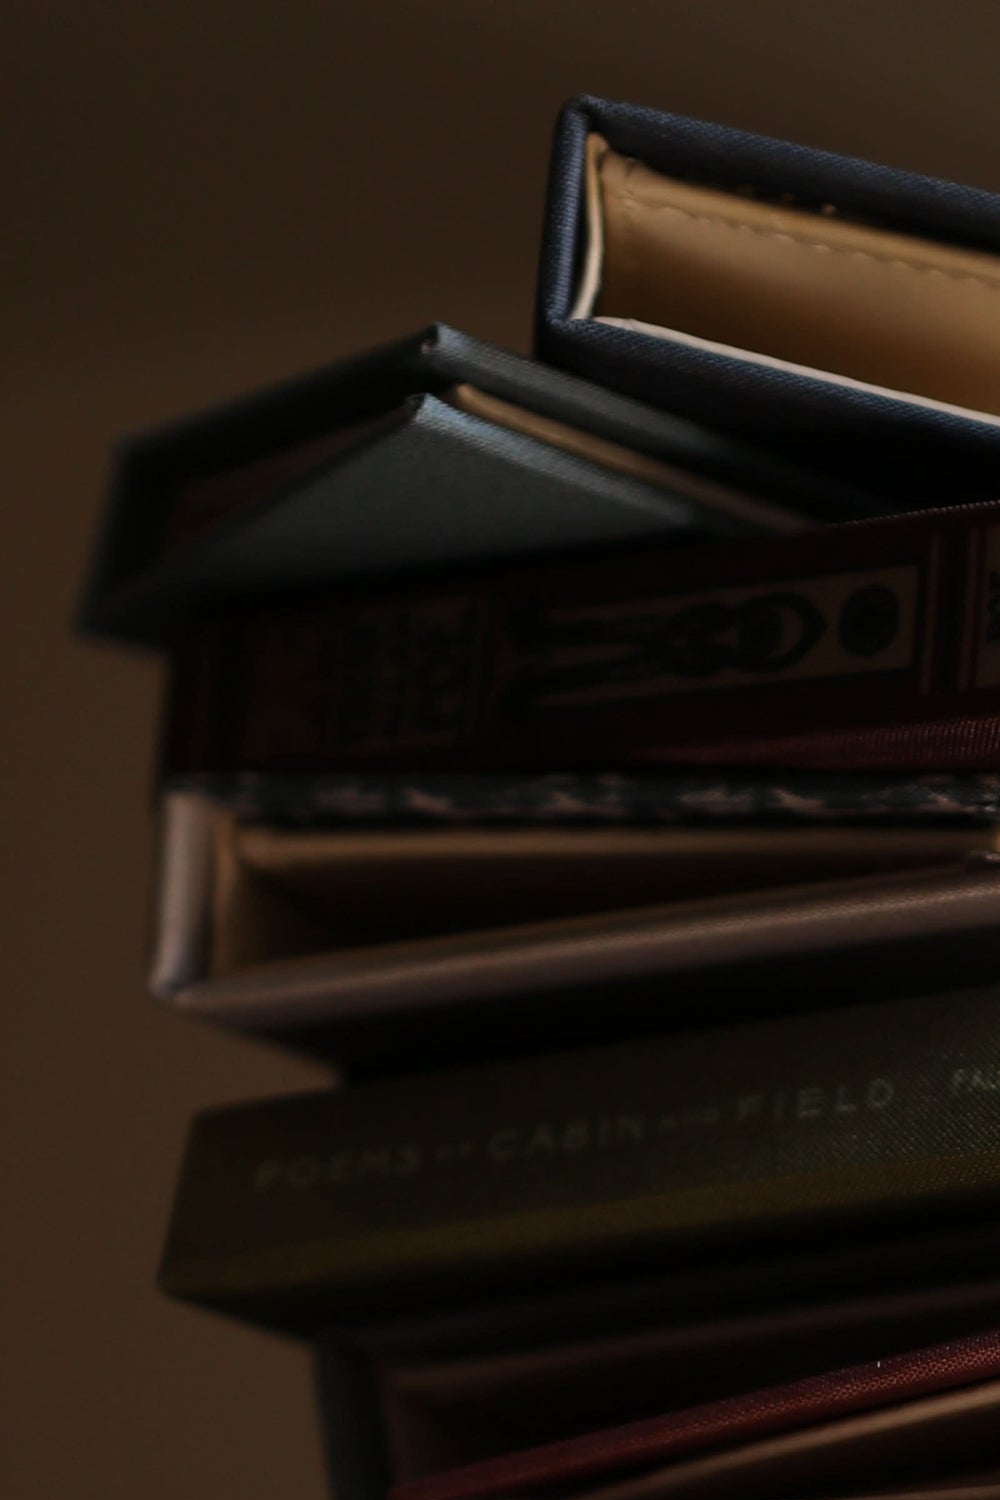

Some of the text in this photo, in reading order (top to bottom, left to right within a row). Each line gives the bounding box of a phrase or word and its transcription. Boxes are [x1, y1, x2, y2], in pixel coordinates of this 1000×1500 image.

[252, 1142, 423, 1196] POEMS
[486, 1116, 642, 1165] CABIN
[733, 1076, 898, 1130] FIELD
